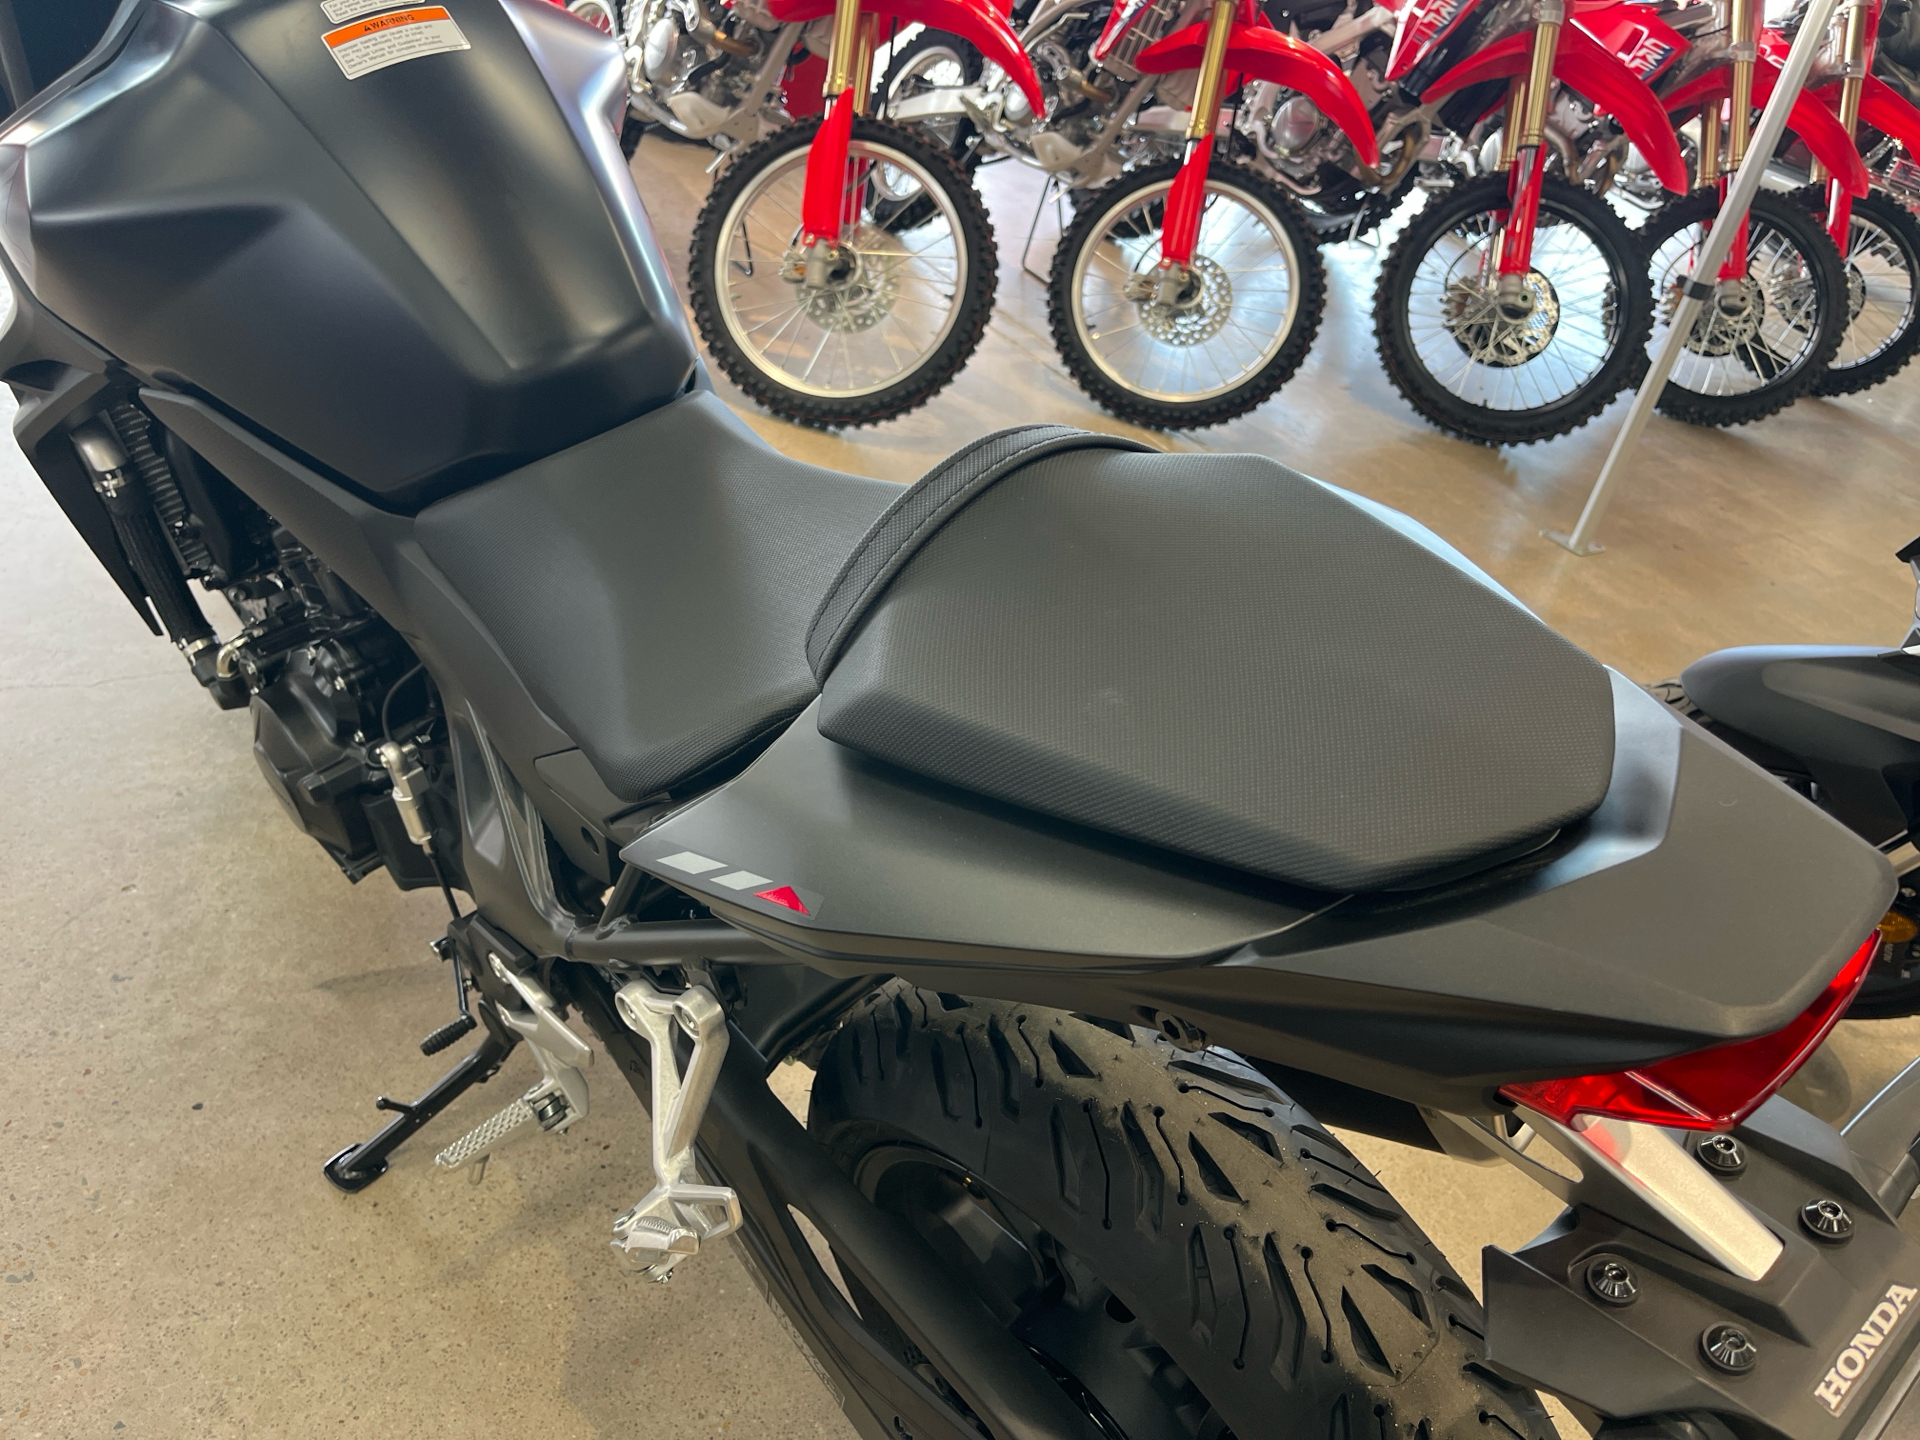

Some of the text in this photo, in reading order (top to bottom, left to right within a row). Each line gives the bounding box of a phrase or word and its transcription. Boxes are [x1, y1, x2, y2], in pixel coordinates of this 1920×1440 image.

[370, 14, 415, 29] WARNING
[1422, 0, 1458, 27] RF
[1628, 37, 1671, 72] CRF
[1814, 1285, 1918, 1410] HONDA
